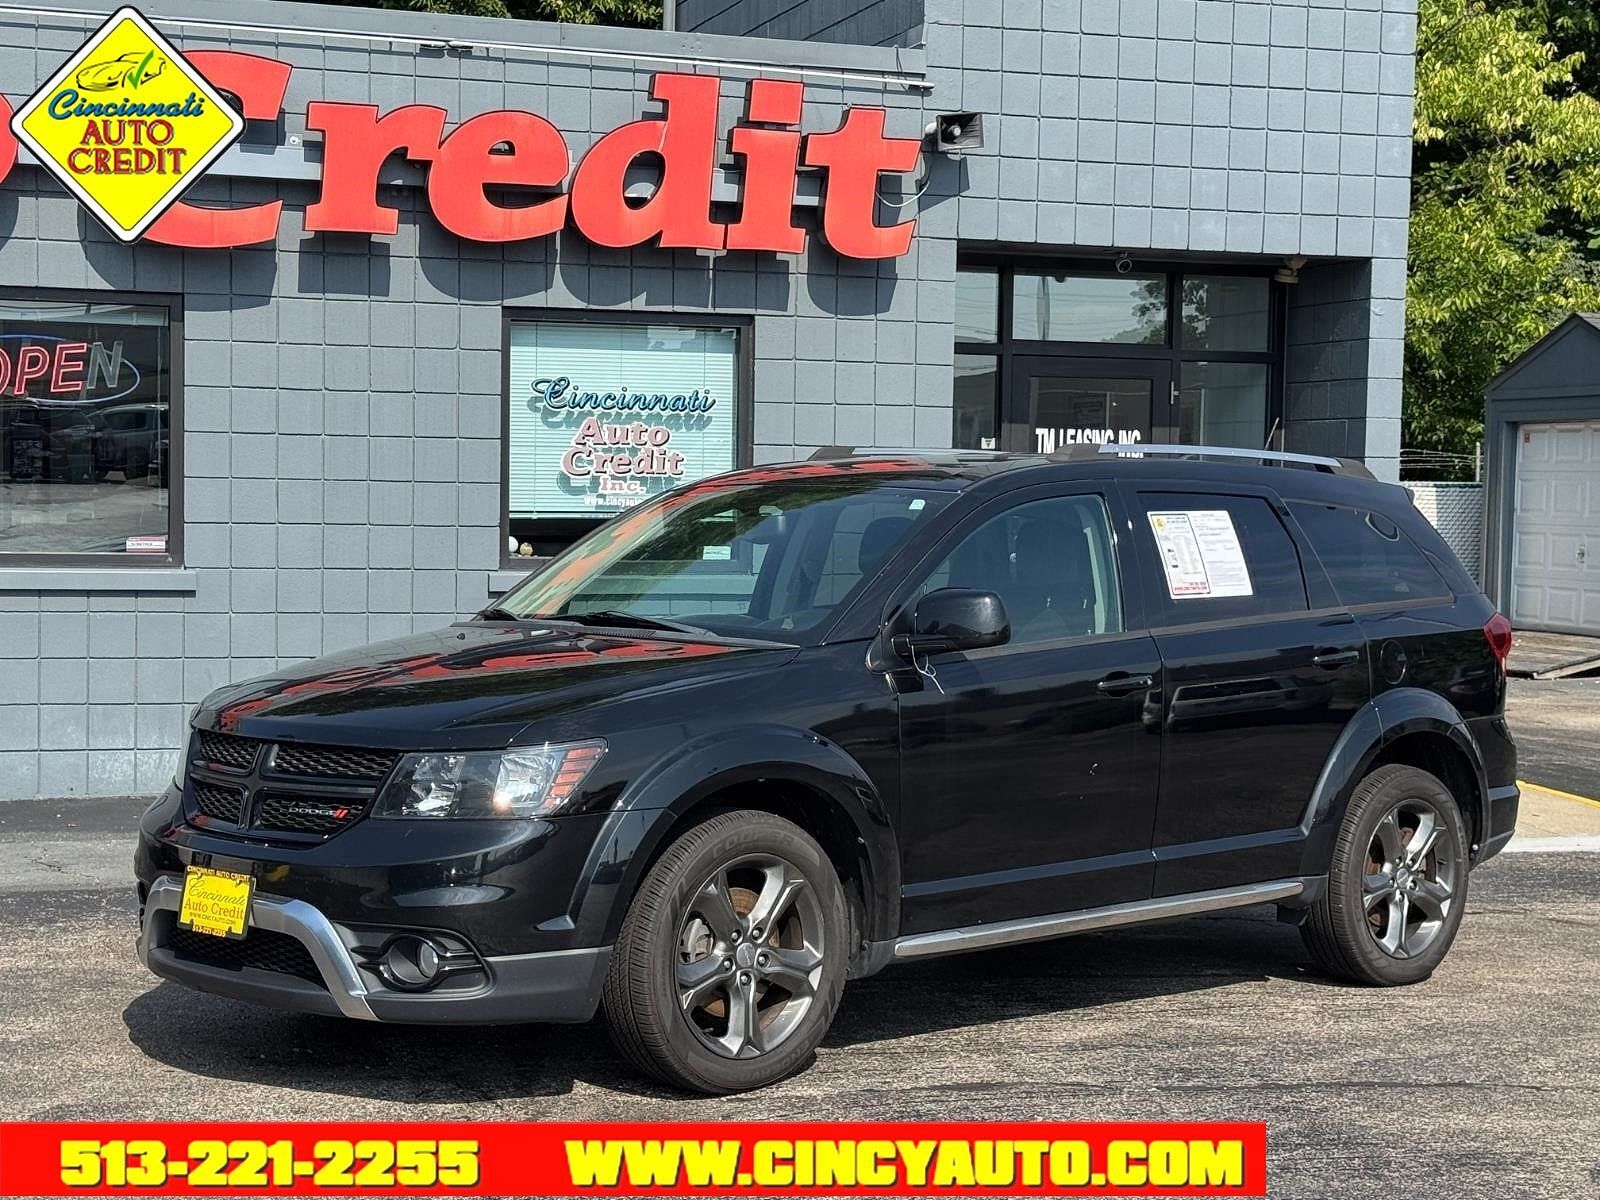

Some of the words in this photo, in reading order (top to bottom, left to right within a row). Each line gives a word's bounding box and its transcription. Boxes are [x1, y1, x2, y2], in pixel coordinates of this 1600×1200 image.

[531, 376, 717, 413] Cincinnati
[575, 417, 670, 447] Auto
[1035, 427, 1056, 454] TM
[562, 448, 684, 477] Credit
[600, 476, 646, 493] Inc.
[289, 807, 337, 817] DODGE
[184, 898, 209, 912] Auto
[211, 902, 244, 919] Credit
